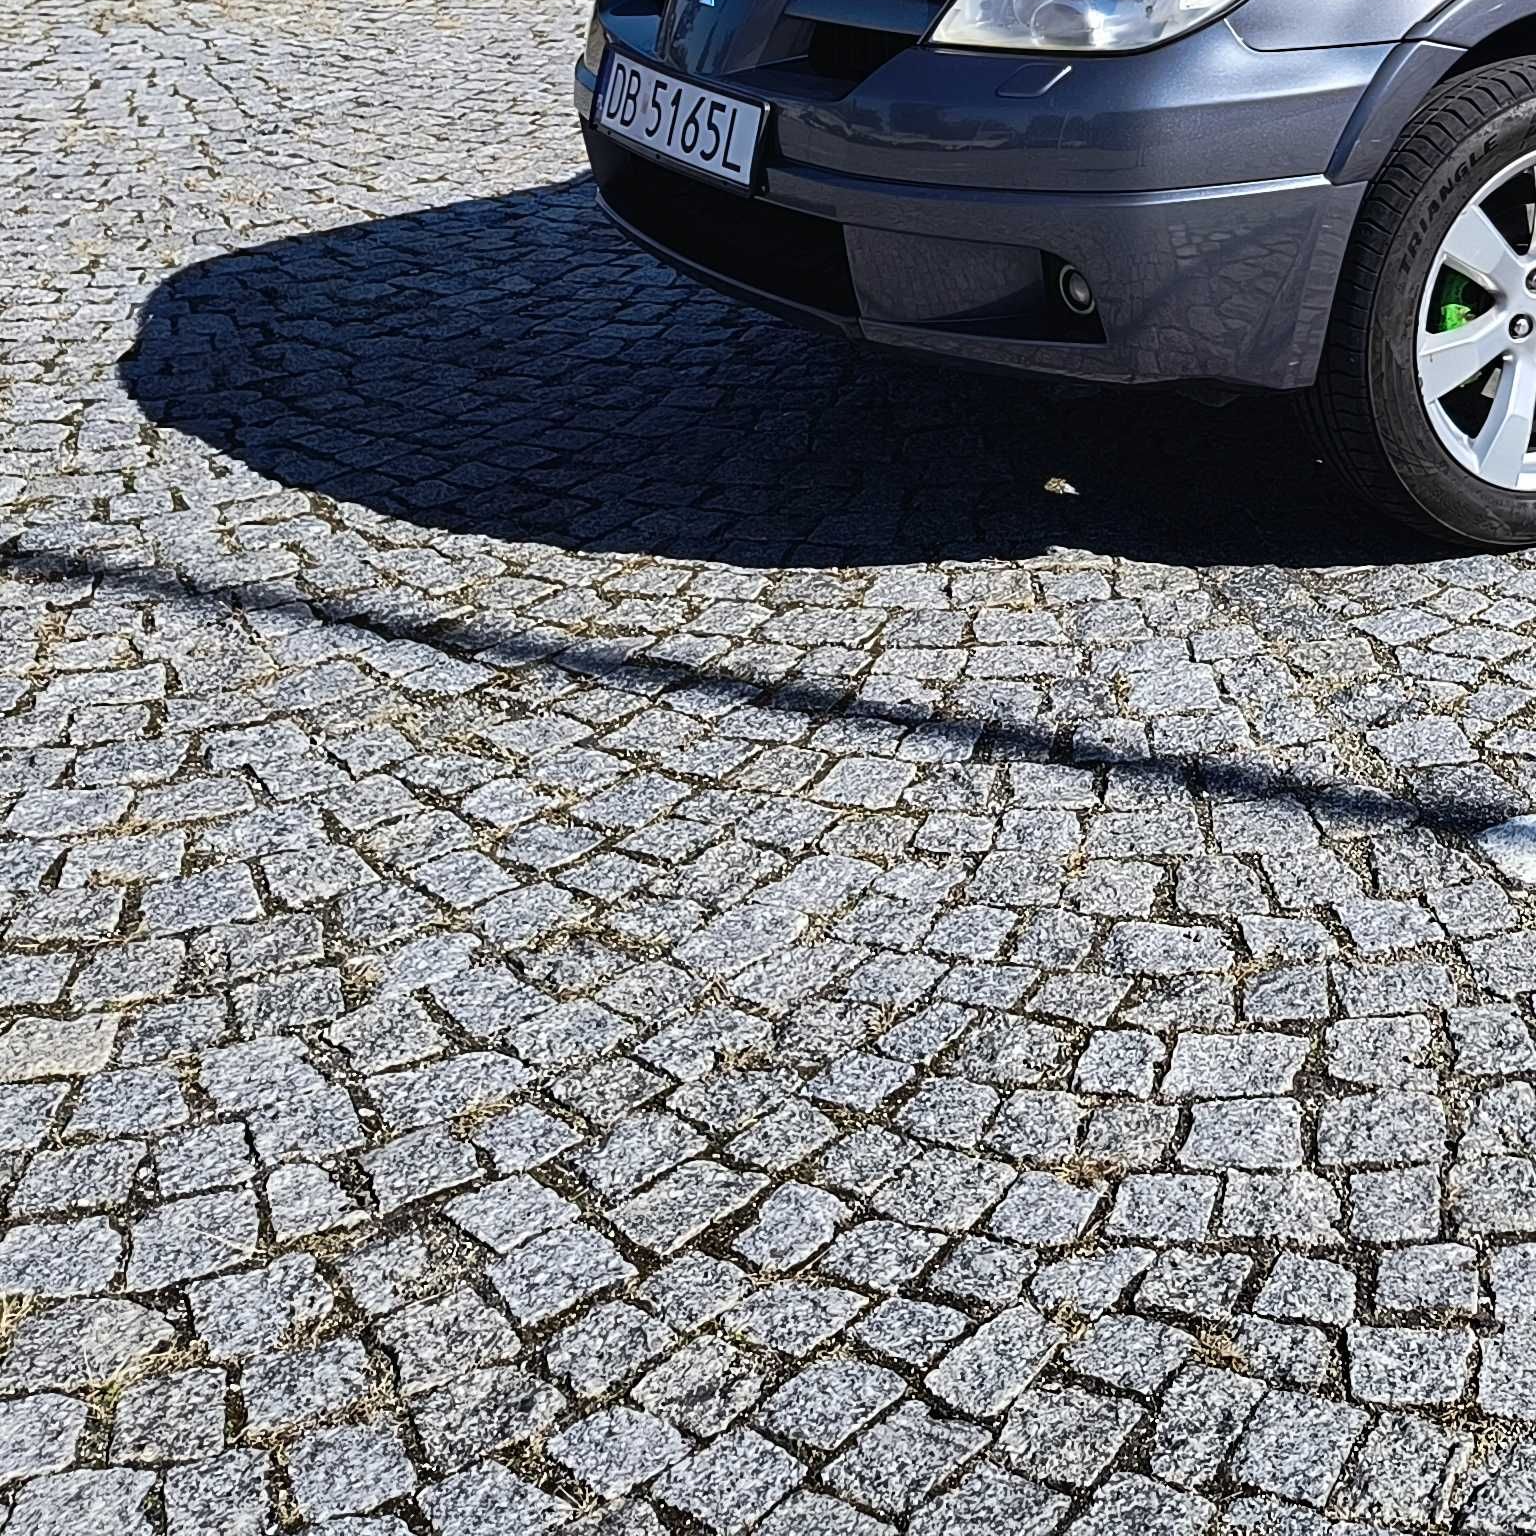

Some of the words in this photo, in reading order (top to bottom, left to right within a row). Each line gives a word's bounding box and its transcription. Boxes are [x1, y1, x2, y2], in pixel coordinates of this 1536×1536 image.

[605, 63, 642, 128] DB
[644, 79, 741, 173] 5165L
[1399, 133, 1499, 276] TRIANGLE
